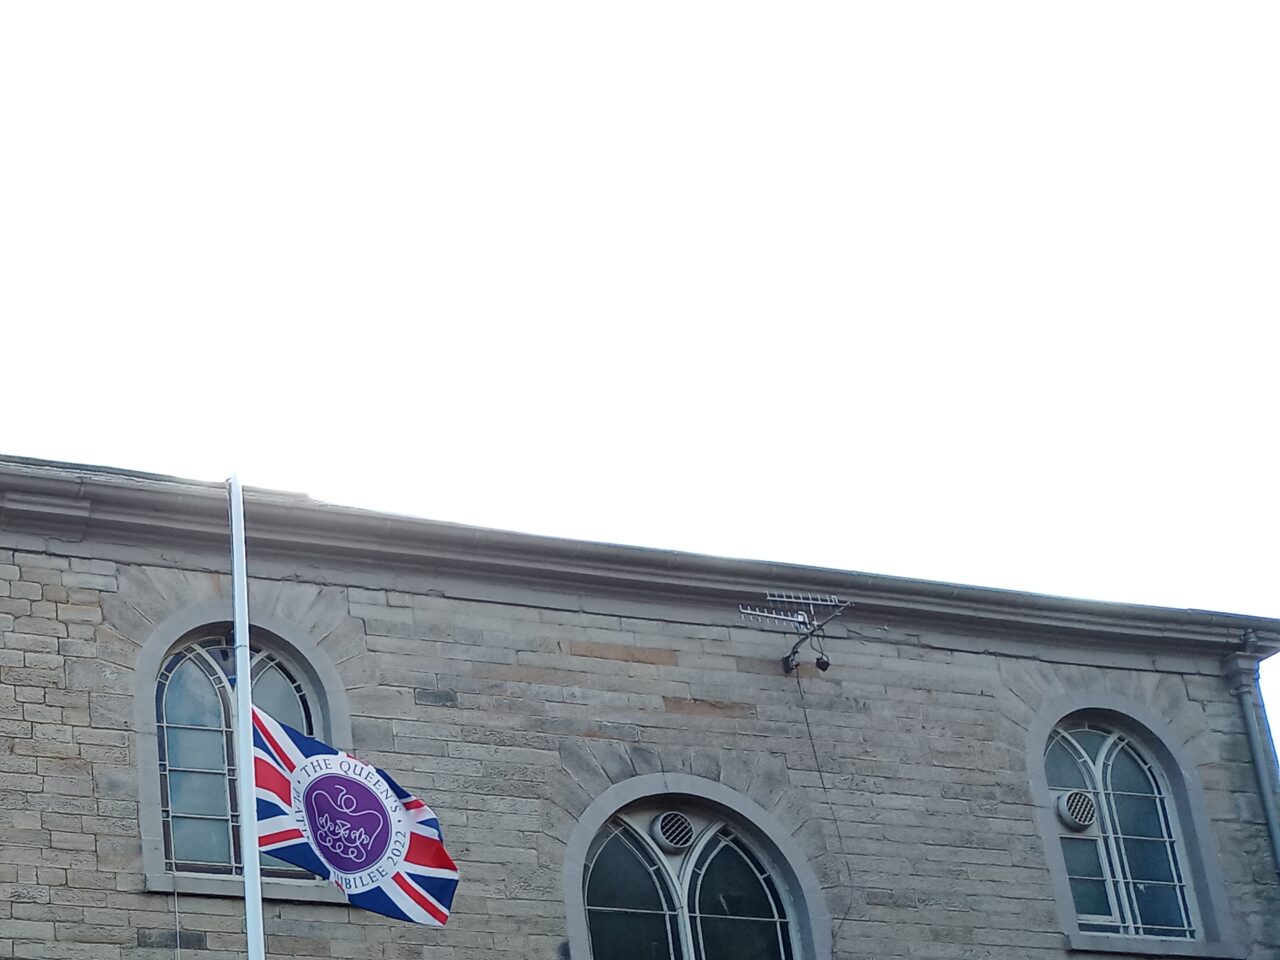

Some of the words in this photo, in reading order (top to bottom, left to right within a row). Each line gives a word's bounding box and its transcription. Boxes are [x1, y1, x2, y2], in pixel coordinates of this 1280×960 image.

[300, 758, 333, 778] THE
[340, 760, 401, 813] QUEEN'S
[387, 830, 407, 867] 2022
